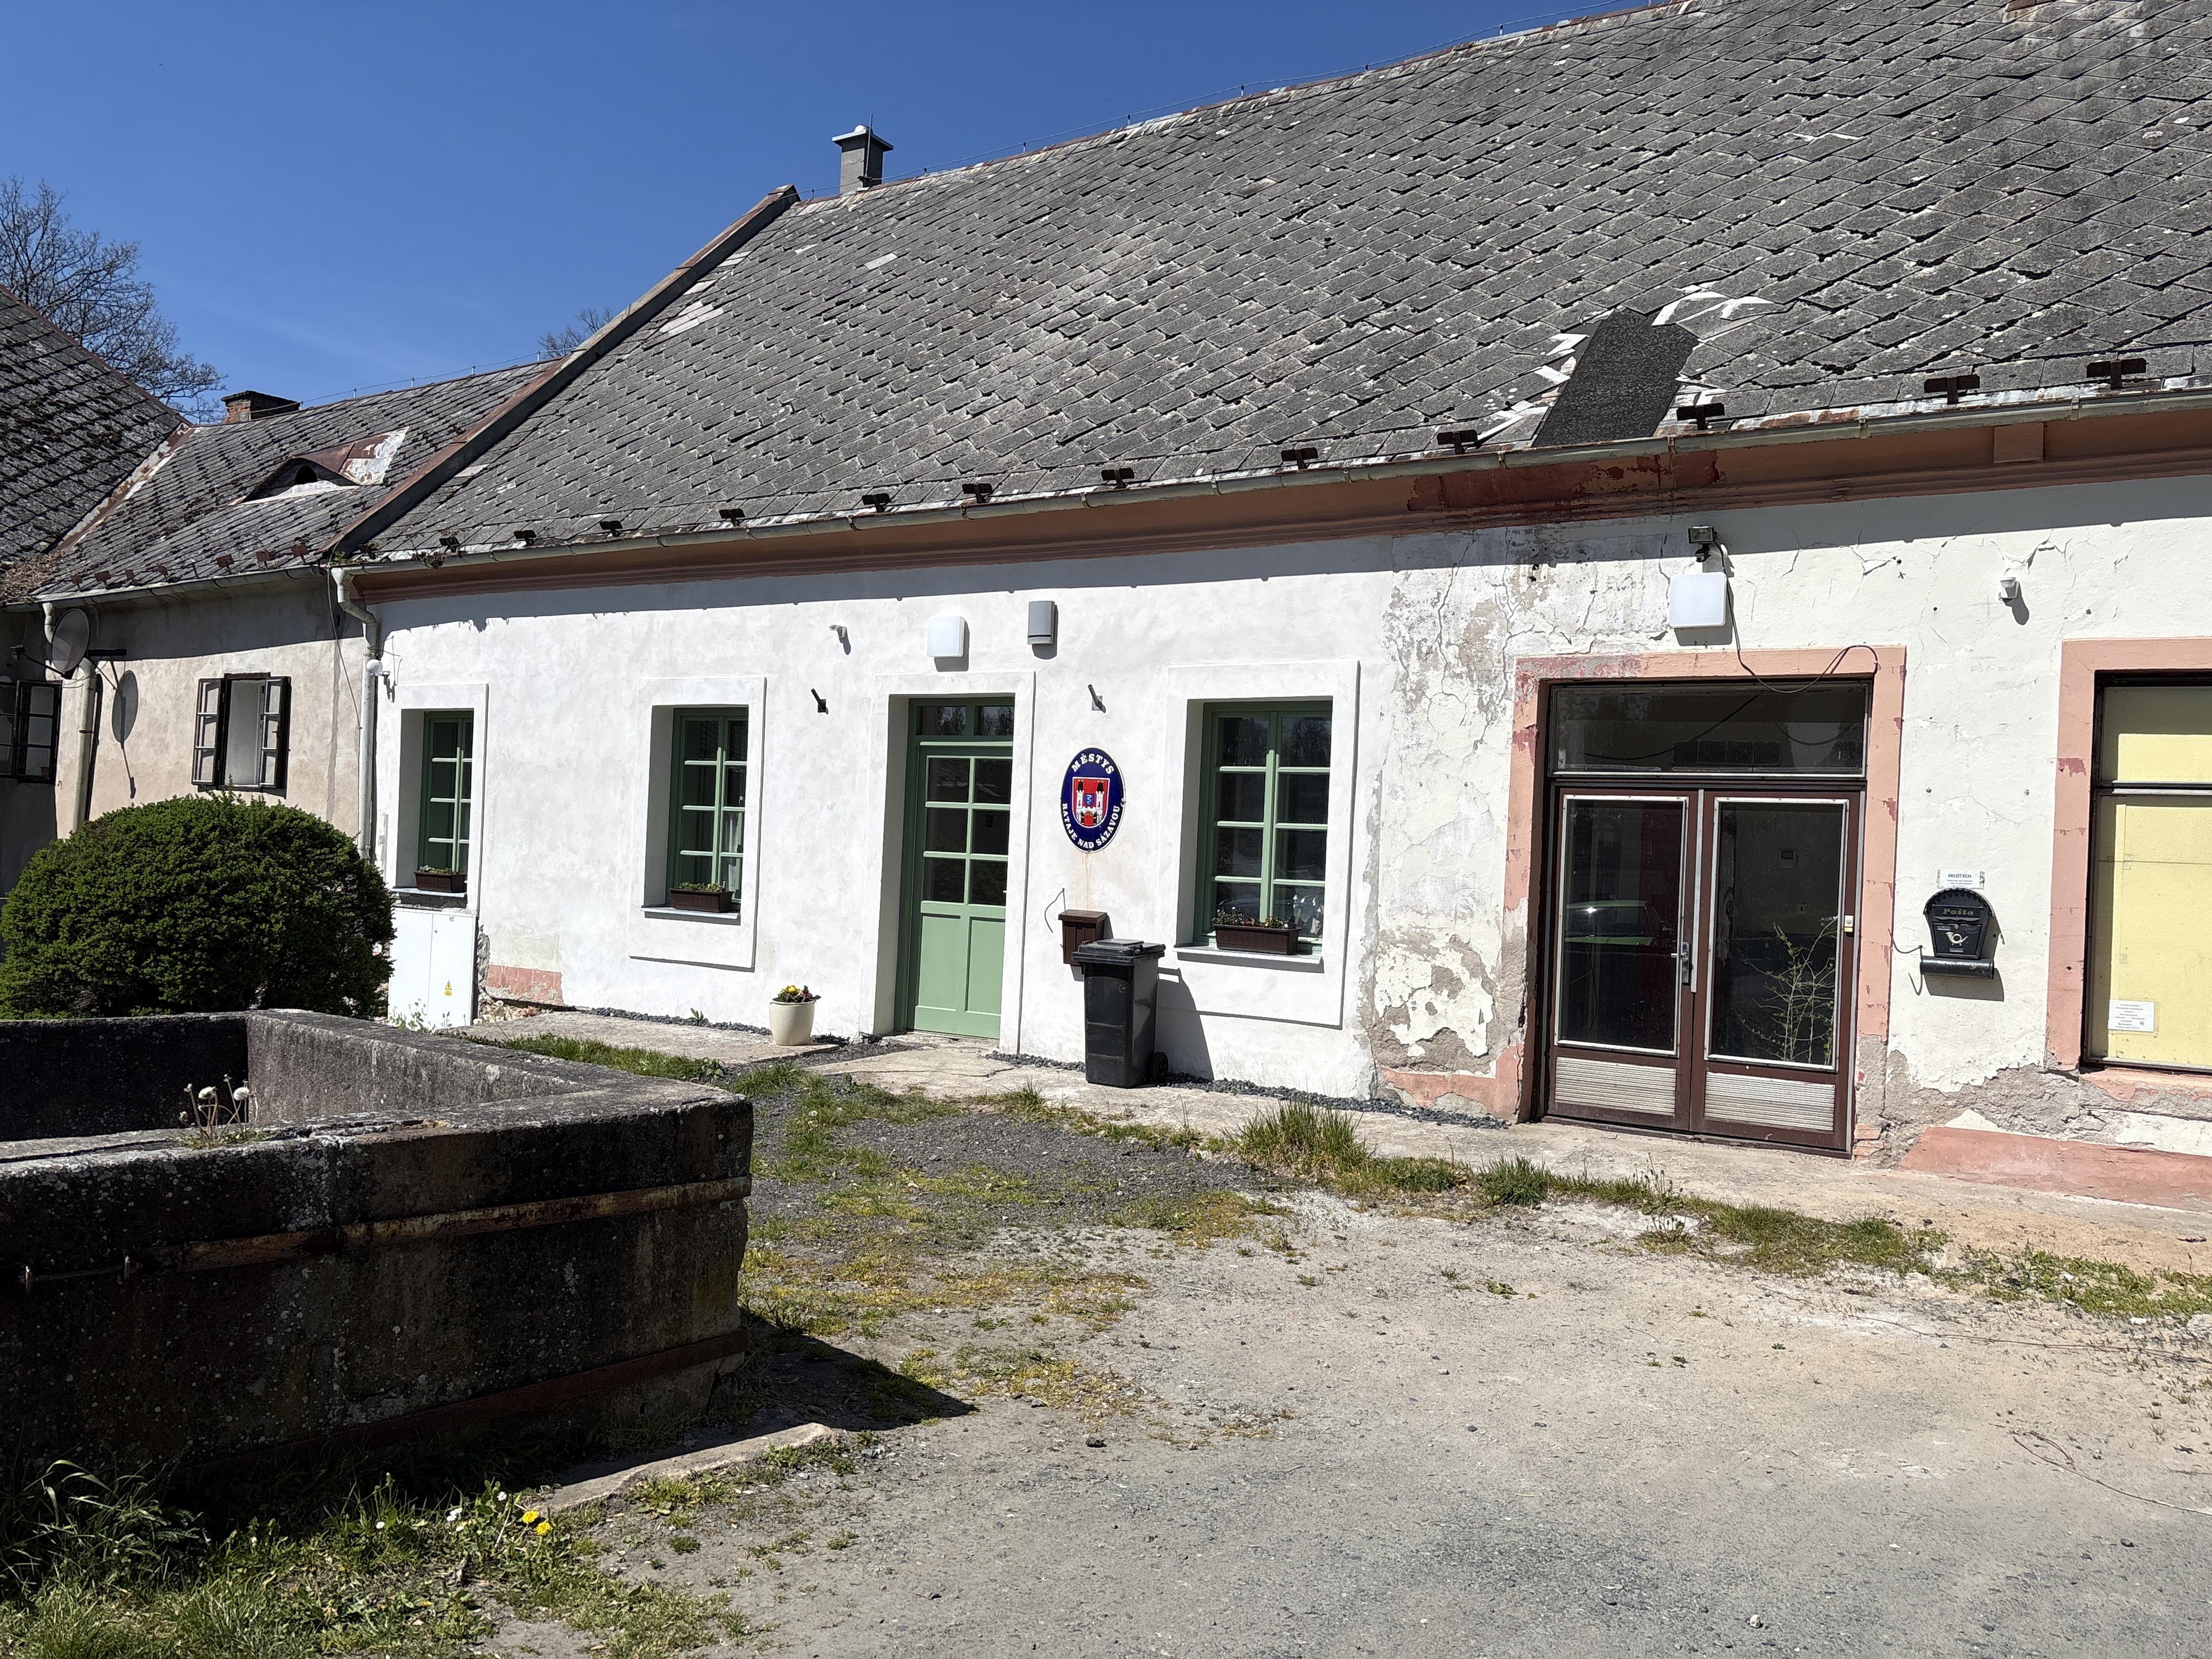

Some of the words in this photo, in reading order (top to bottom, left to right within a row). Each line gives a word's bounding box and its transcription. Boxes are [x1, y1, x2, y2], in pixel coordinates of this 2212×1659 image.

[1072, 753, 1114, 774] MĚSTYS
[1063, 804, 1077, 839] RATAJE
[1078, 839, 1094, 848] NAD
[1096, 806, 1120, 846] SÁZAVOU
